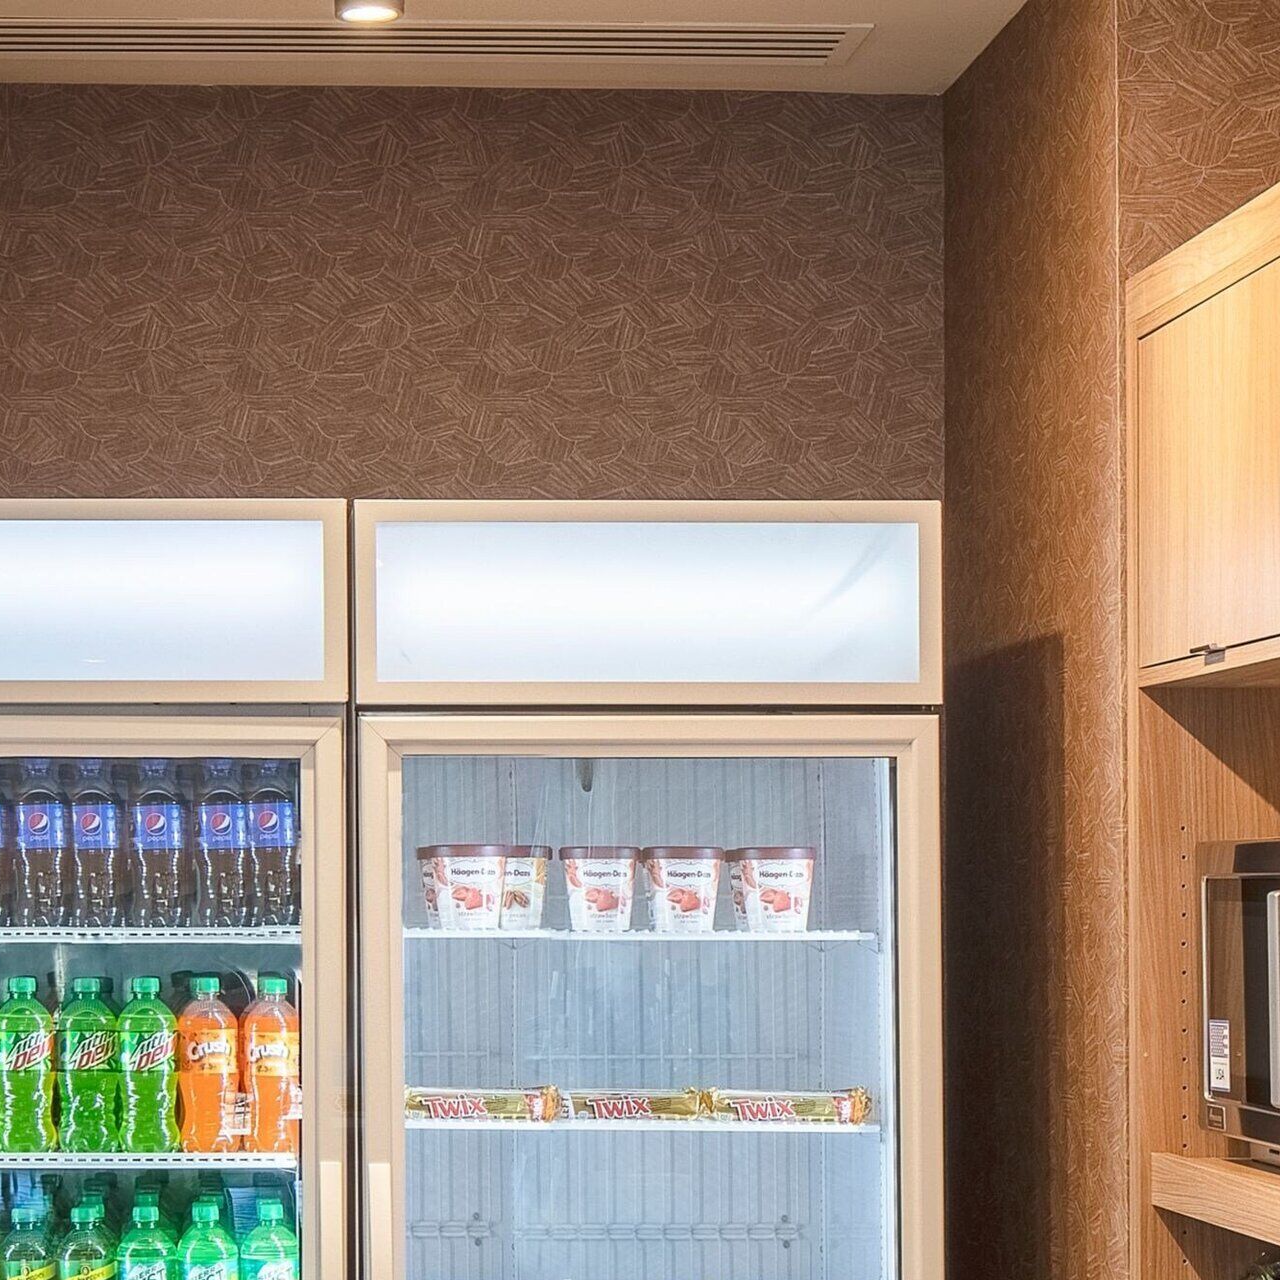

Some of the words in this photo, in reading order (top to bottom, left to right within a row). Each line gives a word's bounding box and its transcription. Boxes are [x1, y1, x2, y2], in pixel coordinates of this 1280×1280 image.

[82, 835, 101, 843] pepsi
[187, 1040, 230, 1061] Crush
[424, 1094, 487, 1118] Twix
[588, 1094, 652, 1119] Twix
[733, 1096, 796, 1121] Twix
